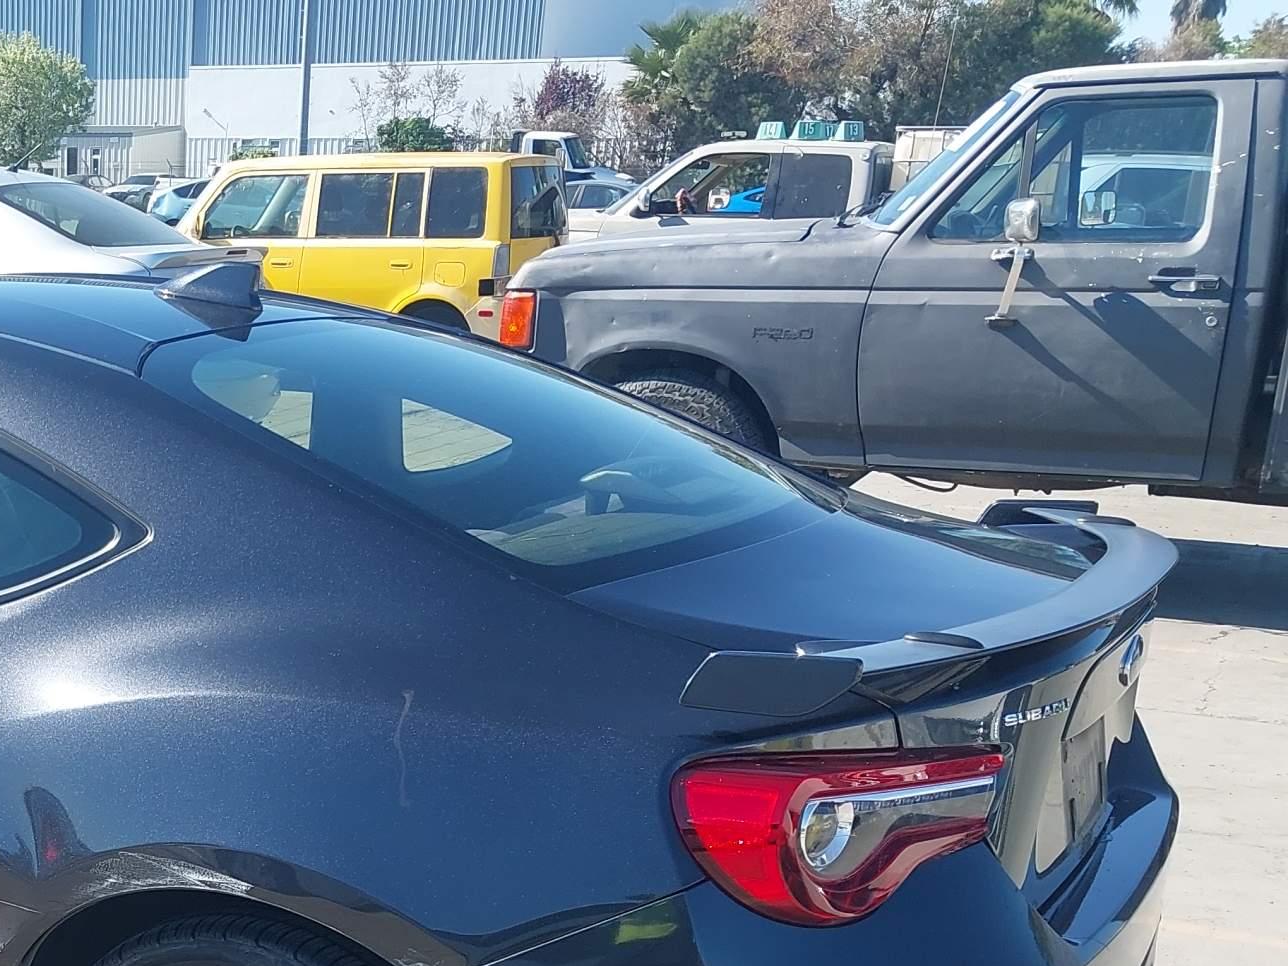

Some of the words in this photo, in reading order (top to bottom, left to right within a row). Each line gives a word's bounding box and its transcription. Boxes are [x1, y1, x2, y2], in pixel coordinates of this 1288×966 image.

[804, 122, 815, 135] 15
[849, 123, 858, 136] 13
[1004, 698, 1071, 727] SUBARU
